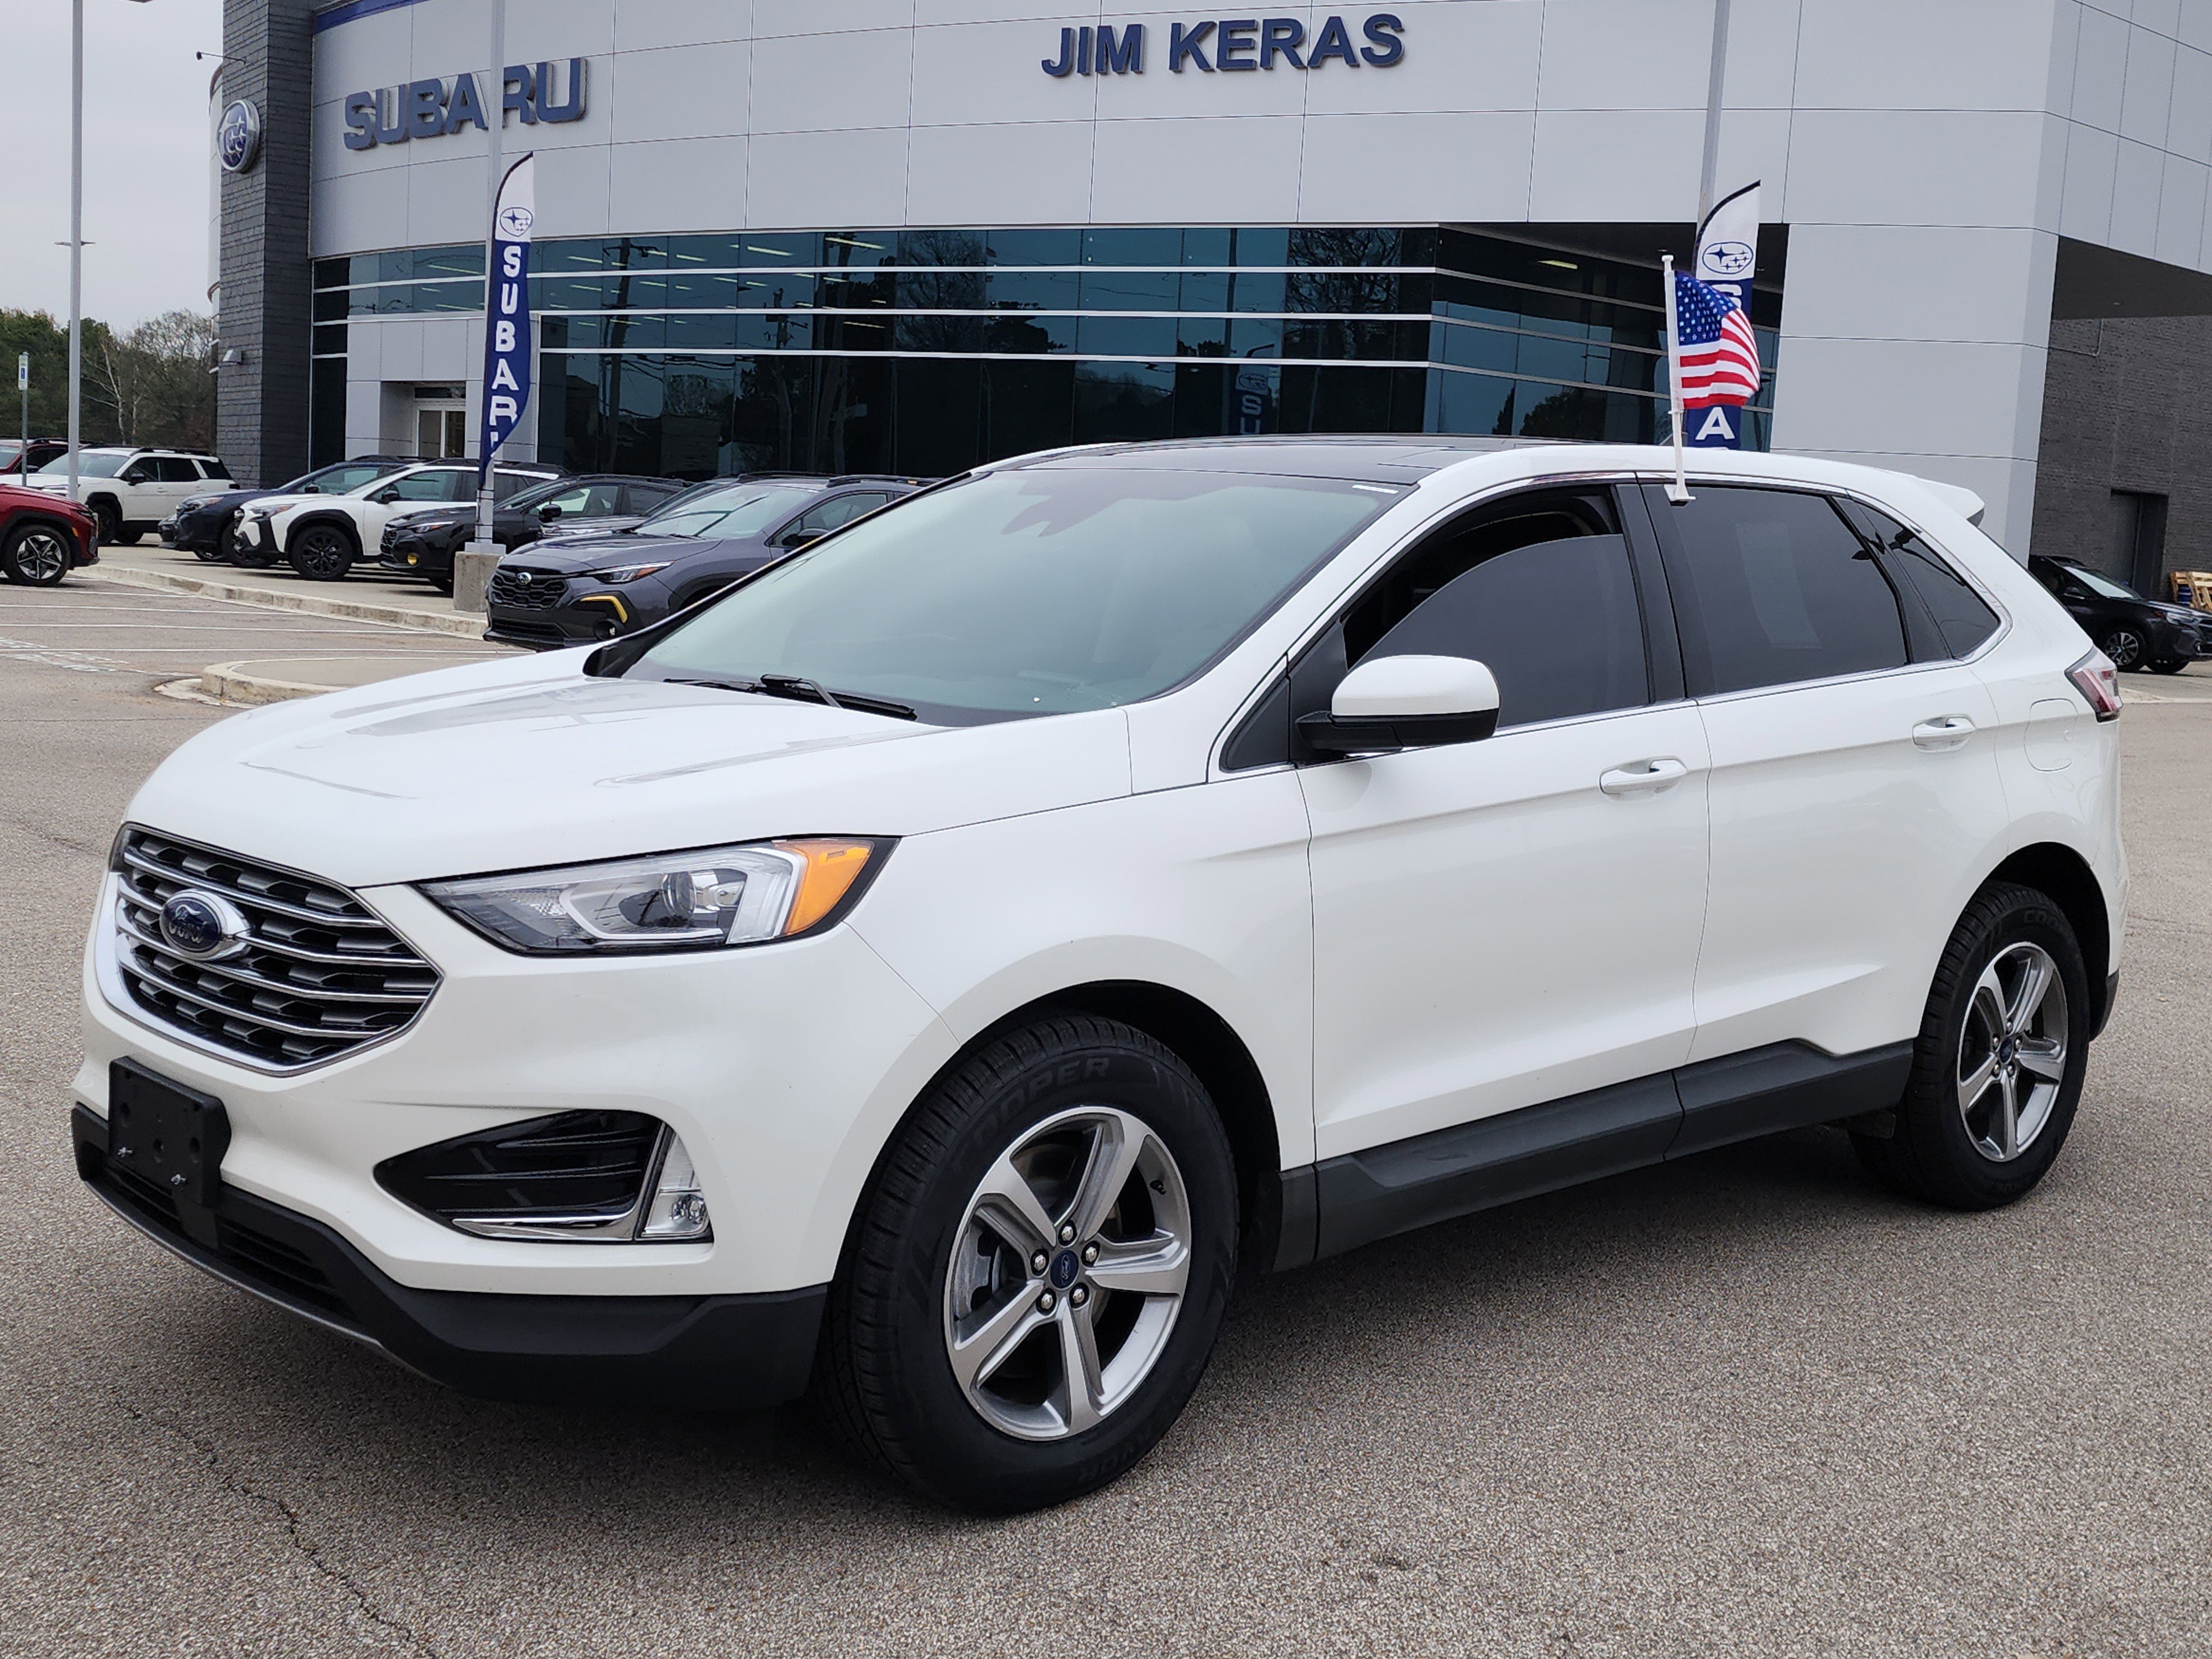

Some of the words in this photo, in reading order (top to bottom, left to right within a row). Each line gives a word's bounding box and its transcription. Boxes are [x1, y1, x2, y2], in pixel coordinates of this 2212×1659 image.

[1041, 23, 1146, 77] JIM
[1168, 14, 1405, 71] KERAS
[343, 57, 586, 150] SUBARU
